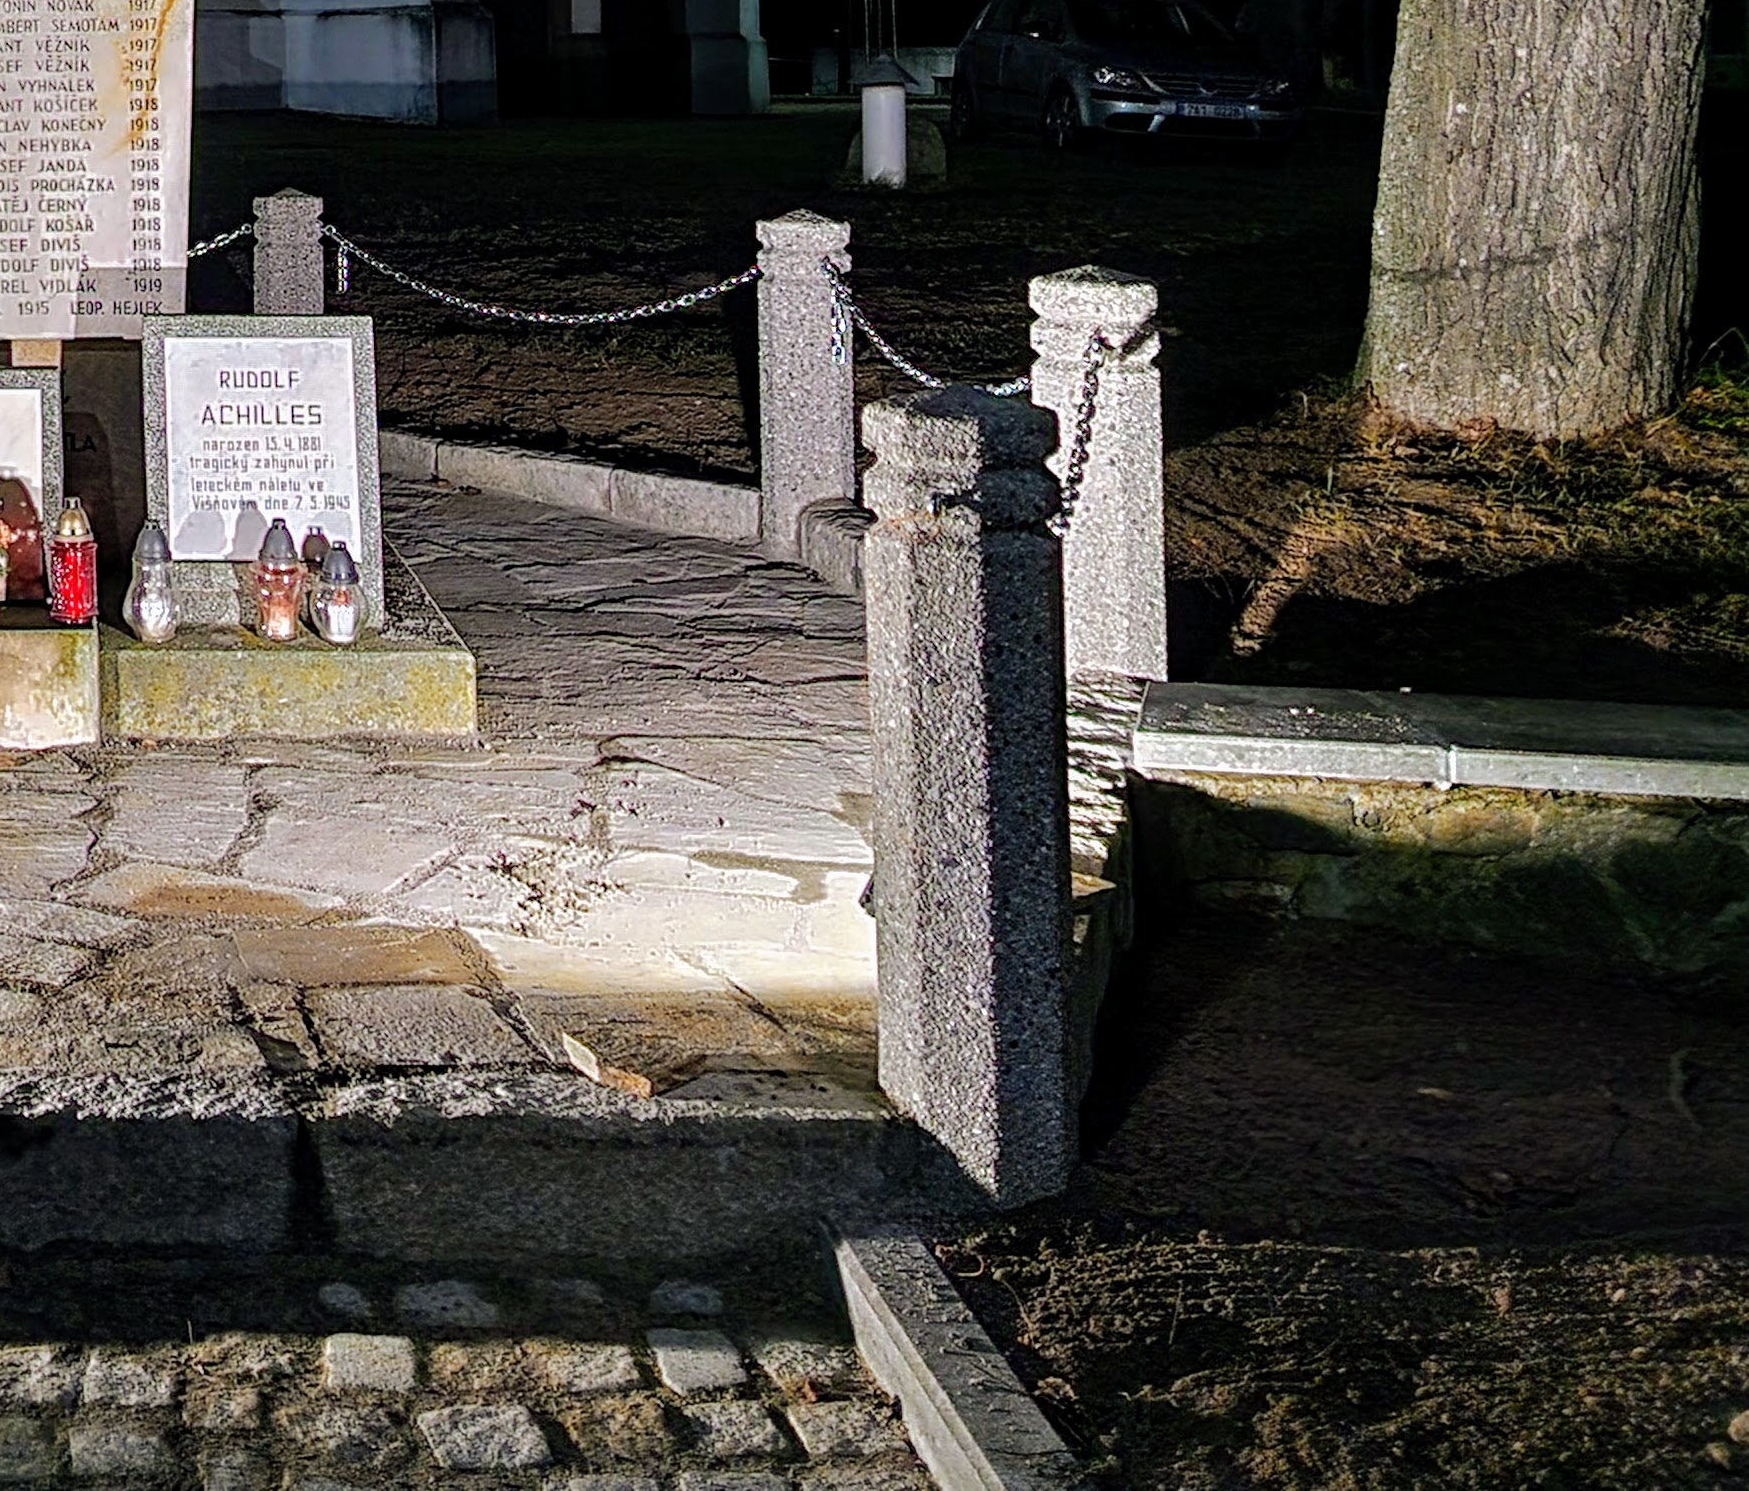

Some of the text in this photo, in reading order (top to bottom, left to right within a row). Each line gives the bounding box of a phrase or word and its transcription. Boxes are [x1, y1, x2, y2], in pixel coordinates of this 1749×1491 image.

[51, 19, 120, 32] SEMOTAM
[130, 19, 157, 31] 1917
[130, 39, 157, 51] 1917
[130, 59, 157, 71] 1917
[130, 79, 157, 91] 1917
[34, 94, 98, 113] KOŠÍČEK
[130, 99, 159, 111] 1918
[131, 118, 159, 131] 1918
[18, 139, 92, 152] NEHYBKA
[131, 138, 159, 151] 1918
[37, 160, 87, 173] JANDA
[131, 159, 159, 171] 1918
[31, 175, 116, 192] PROCHÁZKA
[131, 179, 160, 191] 1918
[38, 194, 88, 212] ČERNÝ
[133, 199, 160, 211] 1918
[133, 218, 161, 231] 1918
[41, 234, 81, 252] DIVIŠ
[133, 238, 161, 251] 1918
[51, 255, 90, 272] DIVIŠ
[133, 259, 161, 272] 1918
[39, 274, 97, 293] VIDLÁK
[134, 279, 162, 292] 1919
[18, 302, 49, 315] 1915
[71, 302, 105, 315] LEOP.
[219, 370, 300, 388] RUDOLF
[201, 405, 322, 425] ACHILLES
[203, 439, 260, 451] narozen
[254, 454, 308, 472] zahynul
[191, 476, 324, 492] leteckém náletu ve
[264, 496, 288, 510] dne
